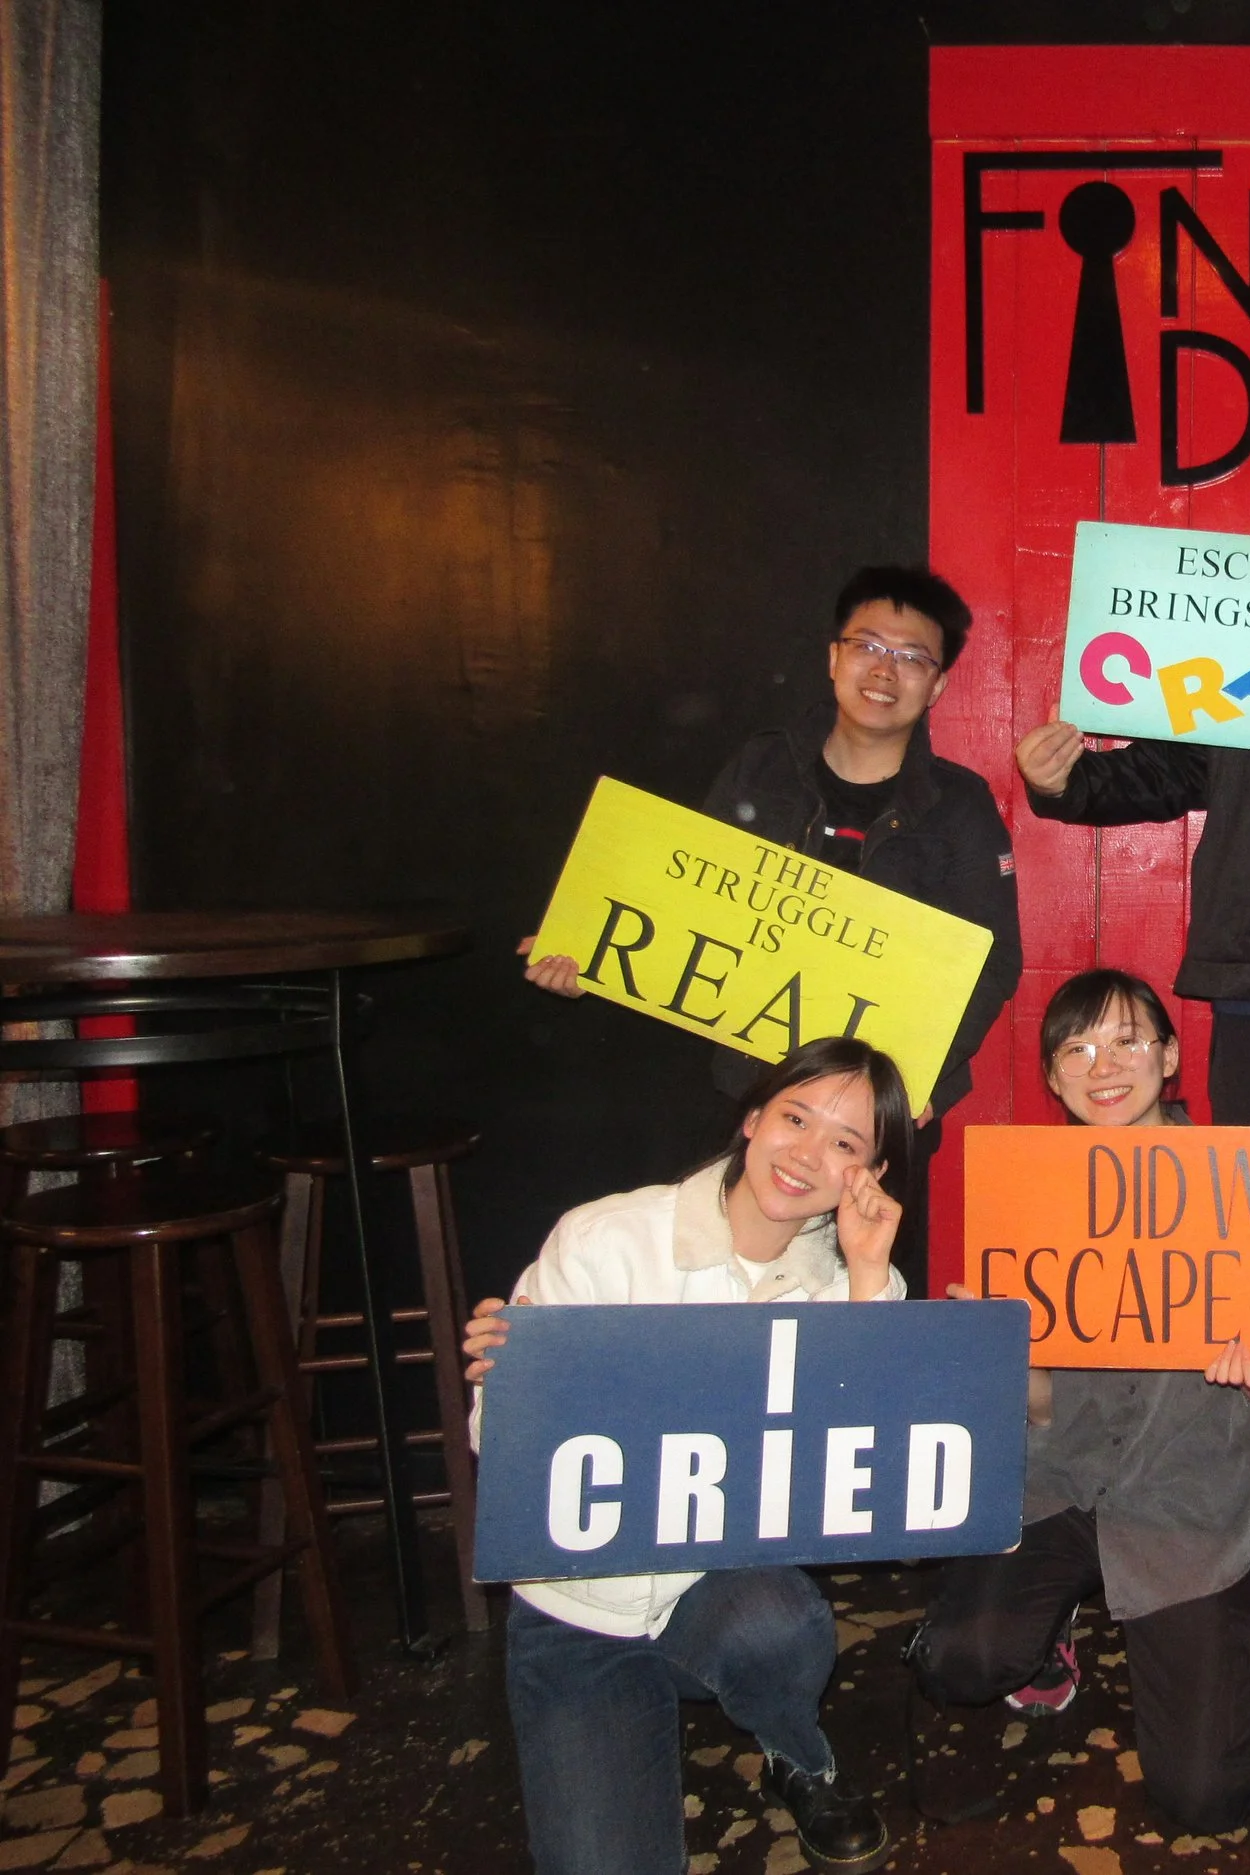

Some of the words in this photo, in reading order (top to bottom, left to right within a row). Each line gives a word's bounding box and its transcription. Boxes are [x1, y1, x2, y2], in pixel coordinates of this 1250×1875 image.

[665, 849, 890, 959] STRUGGLE
[752, 845, 834, 900] THE
[746, 917, 787, 953] IS
[1088, 1144, 1187, 1239] DID
[981, 1247, 1242, 1346] ESCAPE
[766, 1319, 798, 1415] I
[548, 1423, 973, 1552] CRIED
